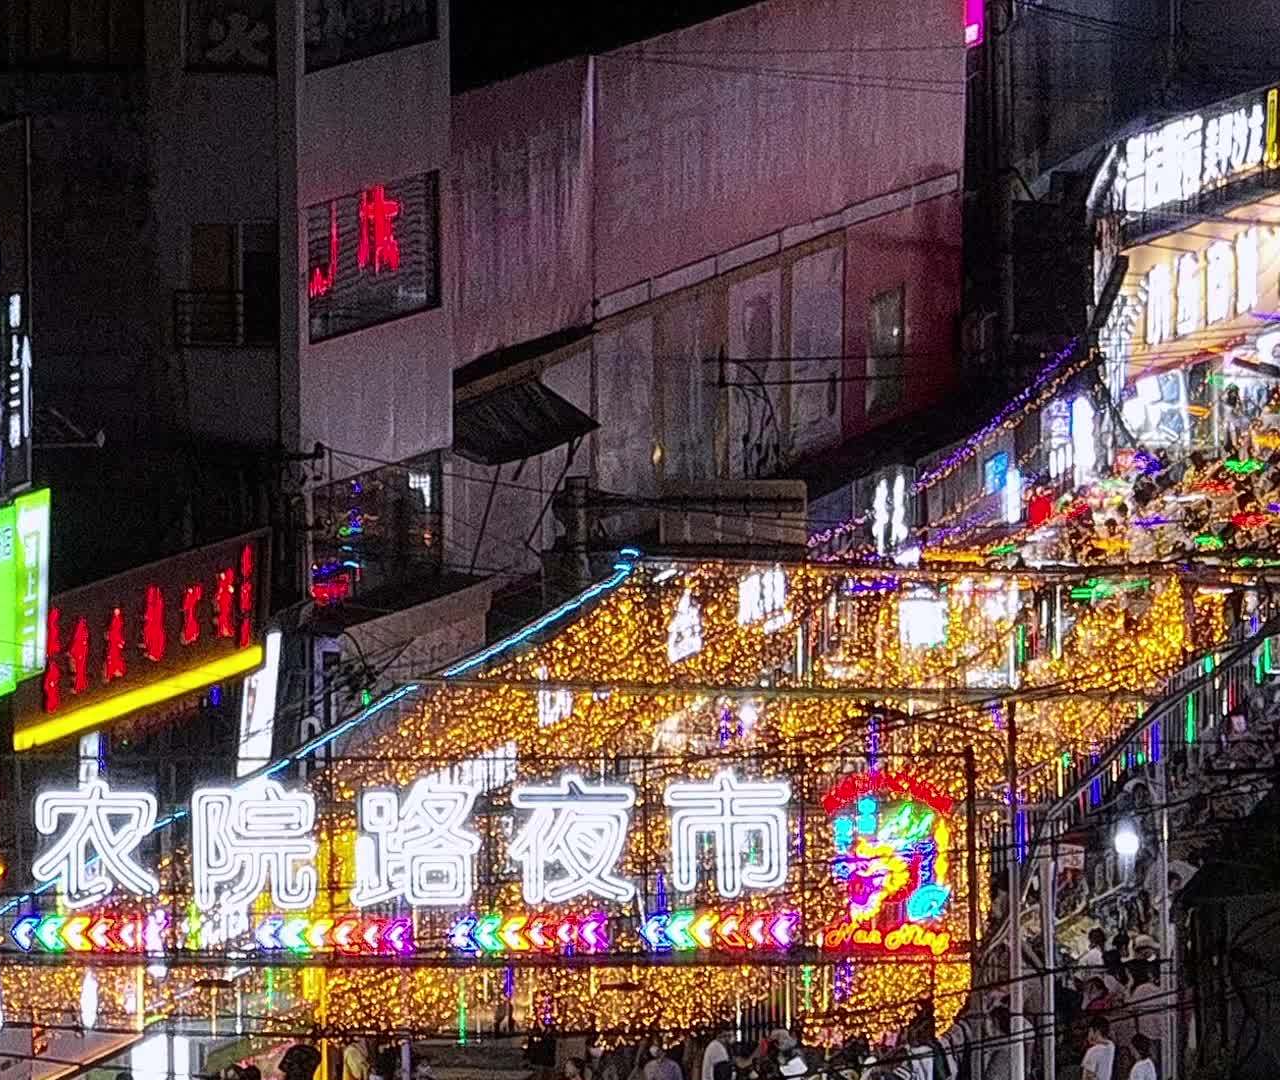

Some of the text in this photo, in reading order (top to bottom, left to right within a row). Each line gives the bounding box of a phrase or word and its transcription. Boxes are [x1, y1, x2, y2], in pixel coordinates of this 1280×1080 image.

[31, 778, 793, 911] 农院路夜市
